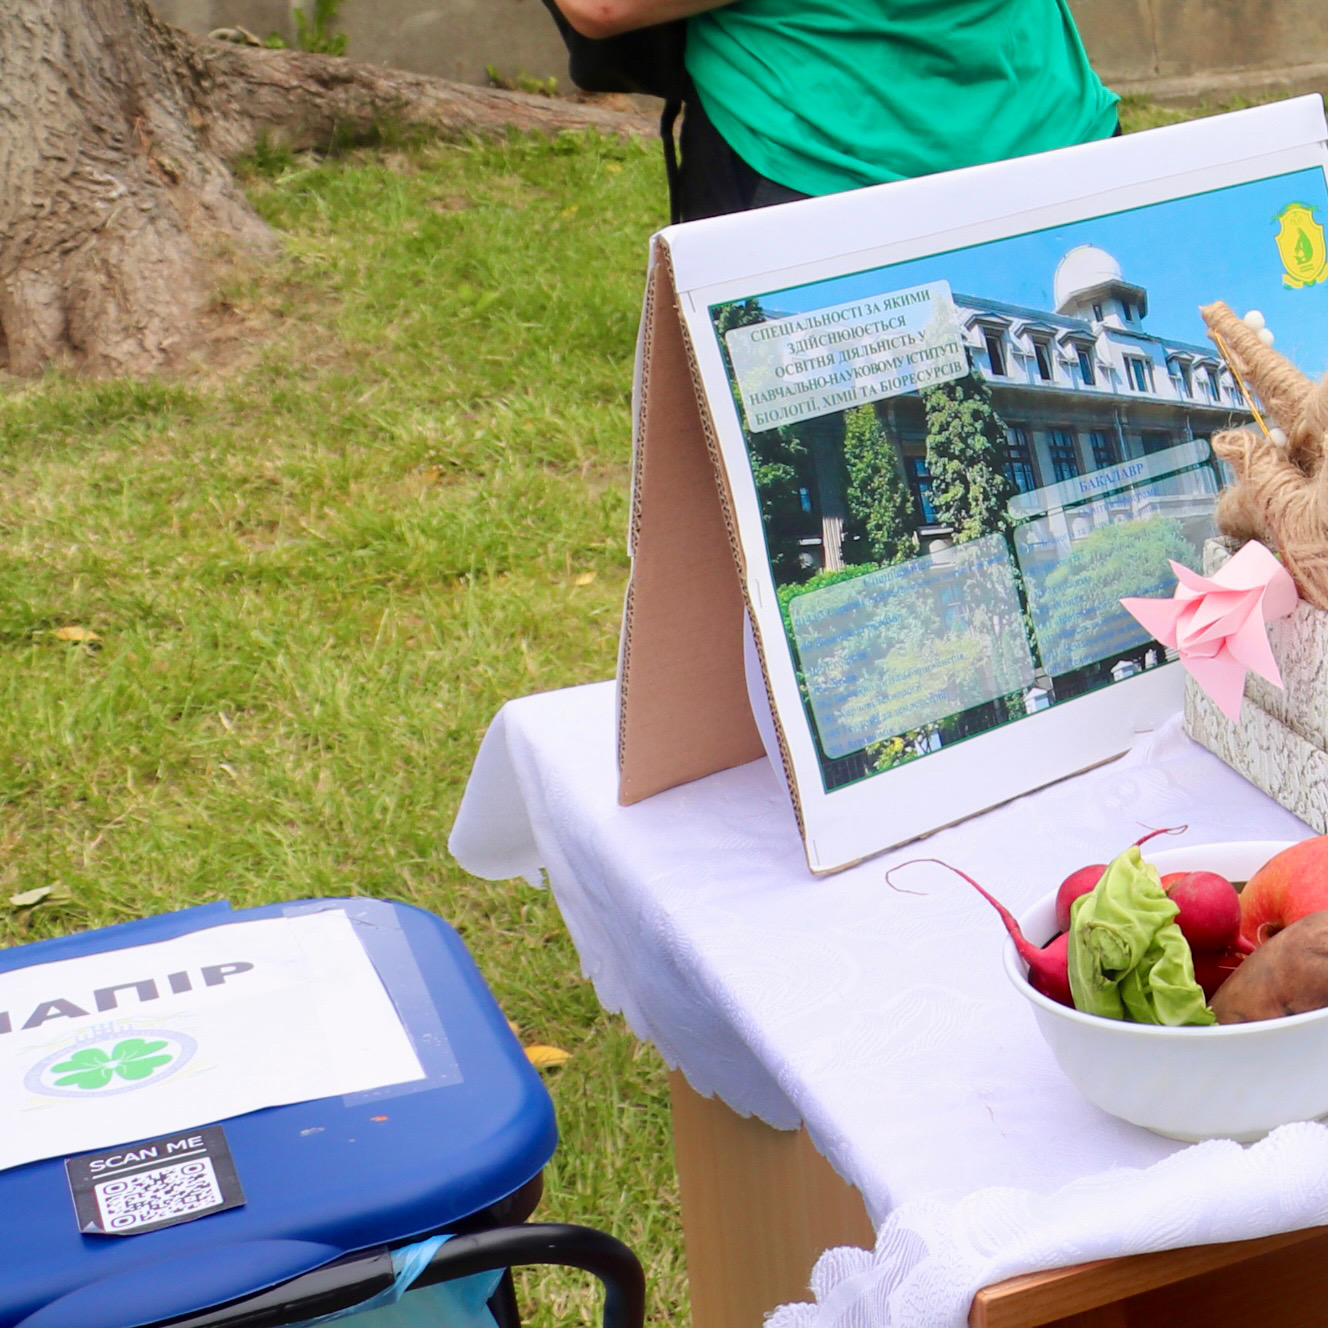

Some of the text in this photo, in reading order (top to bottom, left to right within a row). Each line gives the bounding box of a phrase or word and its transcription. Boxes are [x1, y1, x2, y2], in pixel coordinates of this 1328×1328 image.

[750, 289, 931, 343] СПЕЦІАЛЬНОСТІ ЗА ЯКИМИ
[775, 330, 927, 379] ОСВІТНЯ ДІЯЛЬНІСТЬ У
[749, 355, 904, 406] НАВЧАЛЬНО-НАУКОВОМУ
[755, 361, 962, 426] БІОЛОГІЇ, ХІМІЇ ТА БІОРЕСУРСІВ
[1079, 463, 1144, 494] БАКАЛАВР
[89, 1135, 204, 1174] SCAN ME
